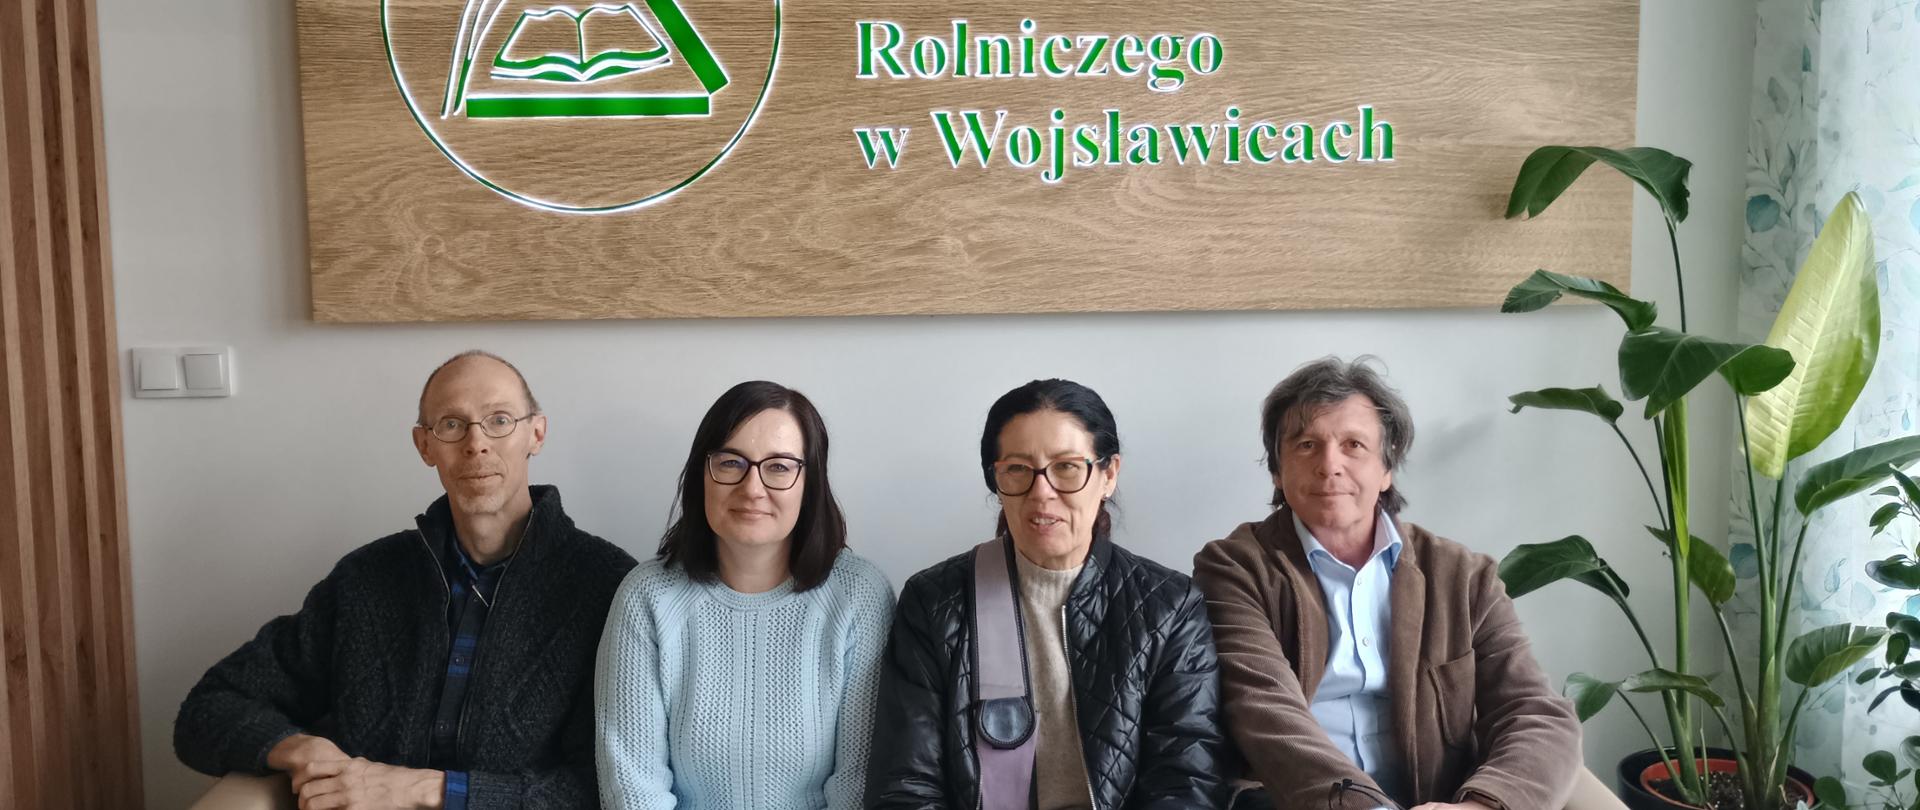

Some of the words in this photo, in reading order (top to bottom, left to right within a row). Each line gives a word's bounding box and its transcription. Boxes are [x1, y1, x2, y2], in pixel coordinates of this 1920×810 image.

[856, 19, 1223, 91] Rolniczego
[854, 127, 909, 169] w
[931, 105, 1395, 183] Wojsławicach
